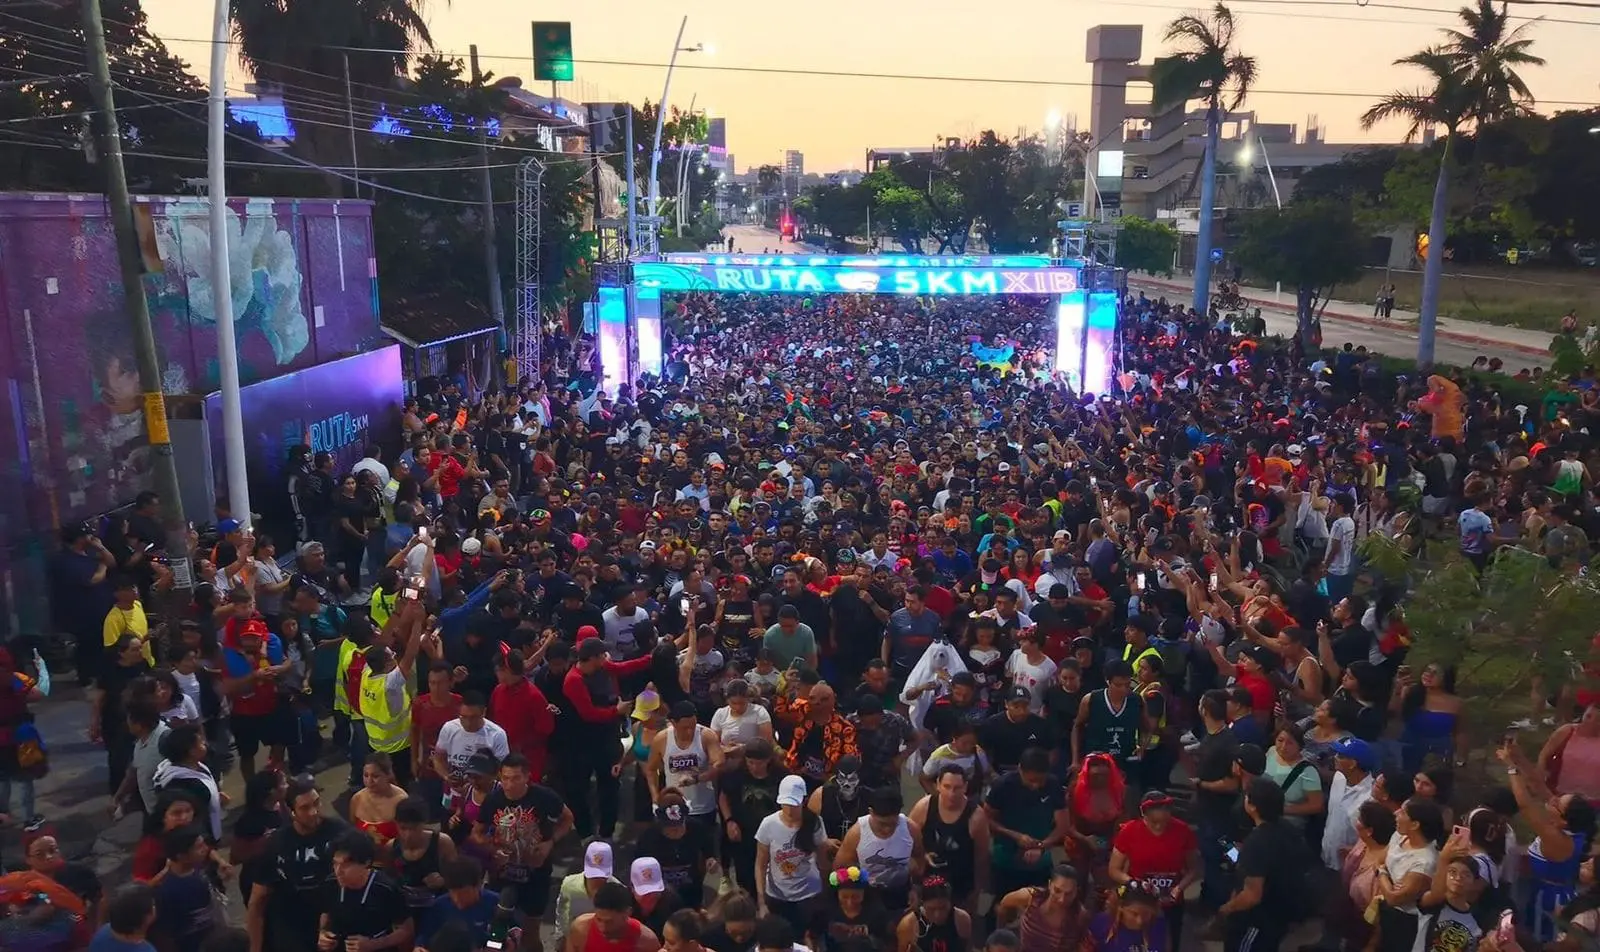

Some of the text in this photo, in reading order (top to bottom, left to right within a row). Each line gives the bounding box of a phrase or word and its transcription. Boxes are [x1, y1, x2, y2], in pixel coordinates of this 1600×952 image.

[1069, 204, 1079, 217] E
[715, 268, 1077, 294] RUTA 5KM XIB
[310, 411, 369, 455] RUTA 5KM
